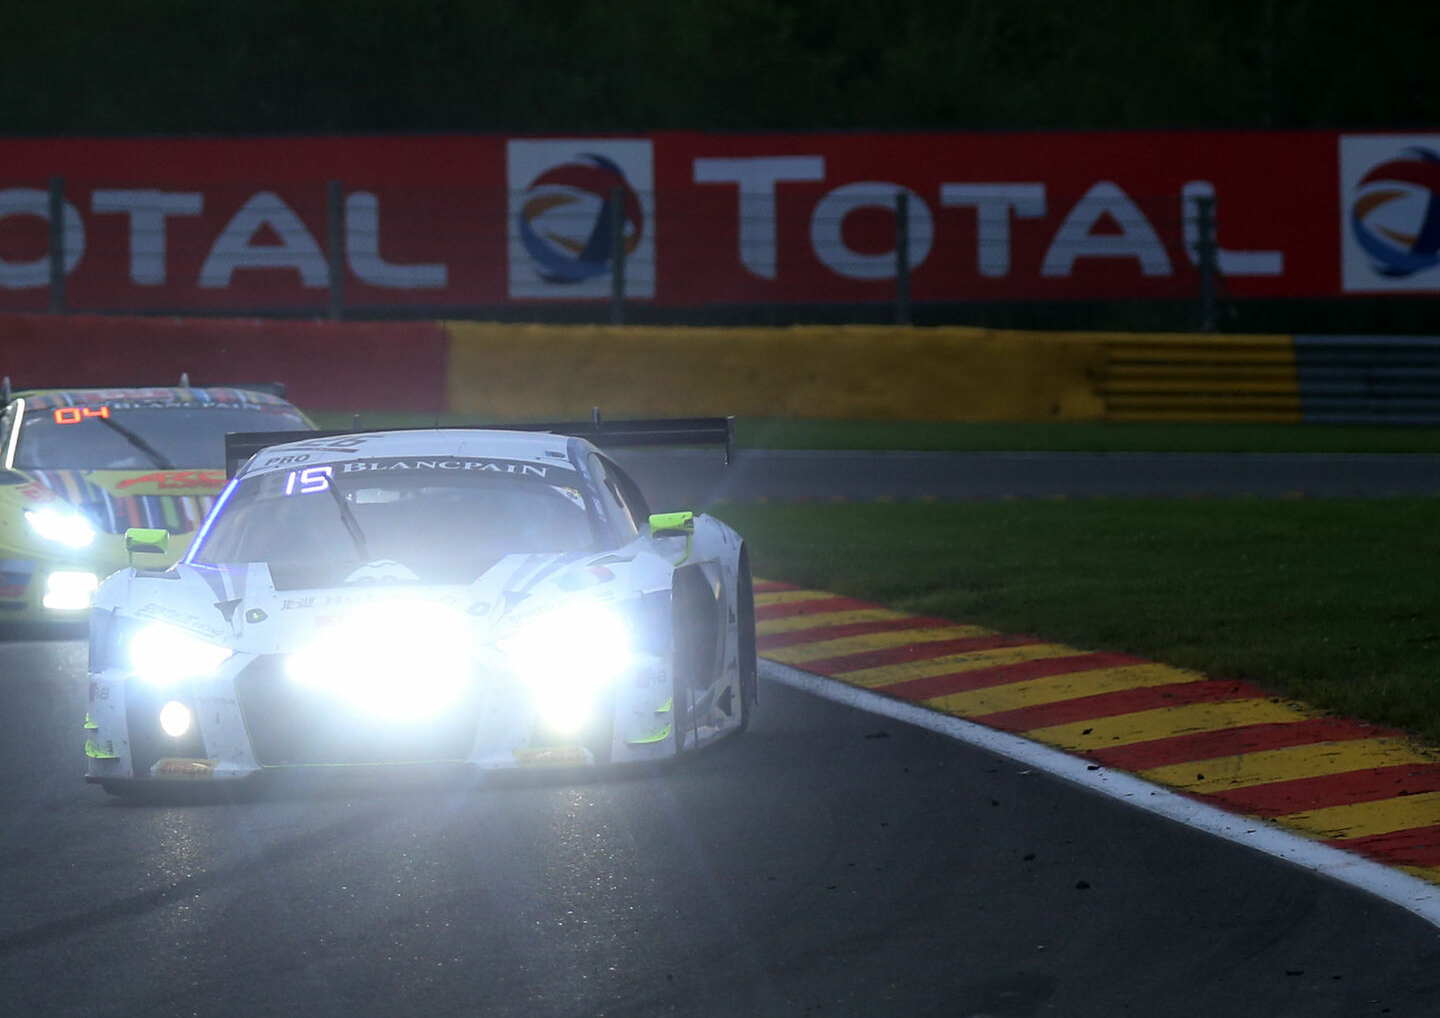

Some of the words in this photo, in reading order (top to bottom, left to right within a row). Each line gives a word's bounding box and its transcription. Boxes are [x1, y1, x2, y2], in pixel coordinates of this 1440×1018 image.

[693, 155, 1283, 280] TOTAL
[54, 405, 111, 425] 04
[264, 453, 310, 467] PRO
[340, 459, 549, 479] BLANCPAIN
